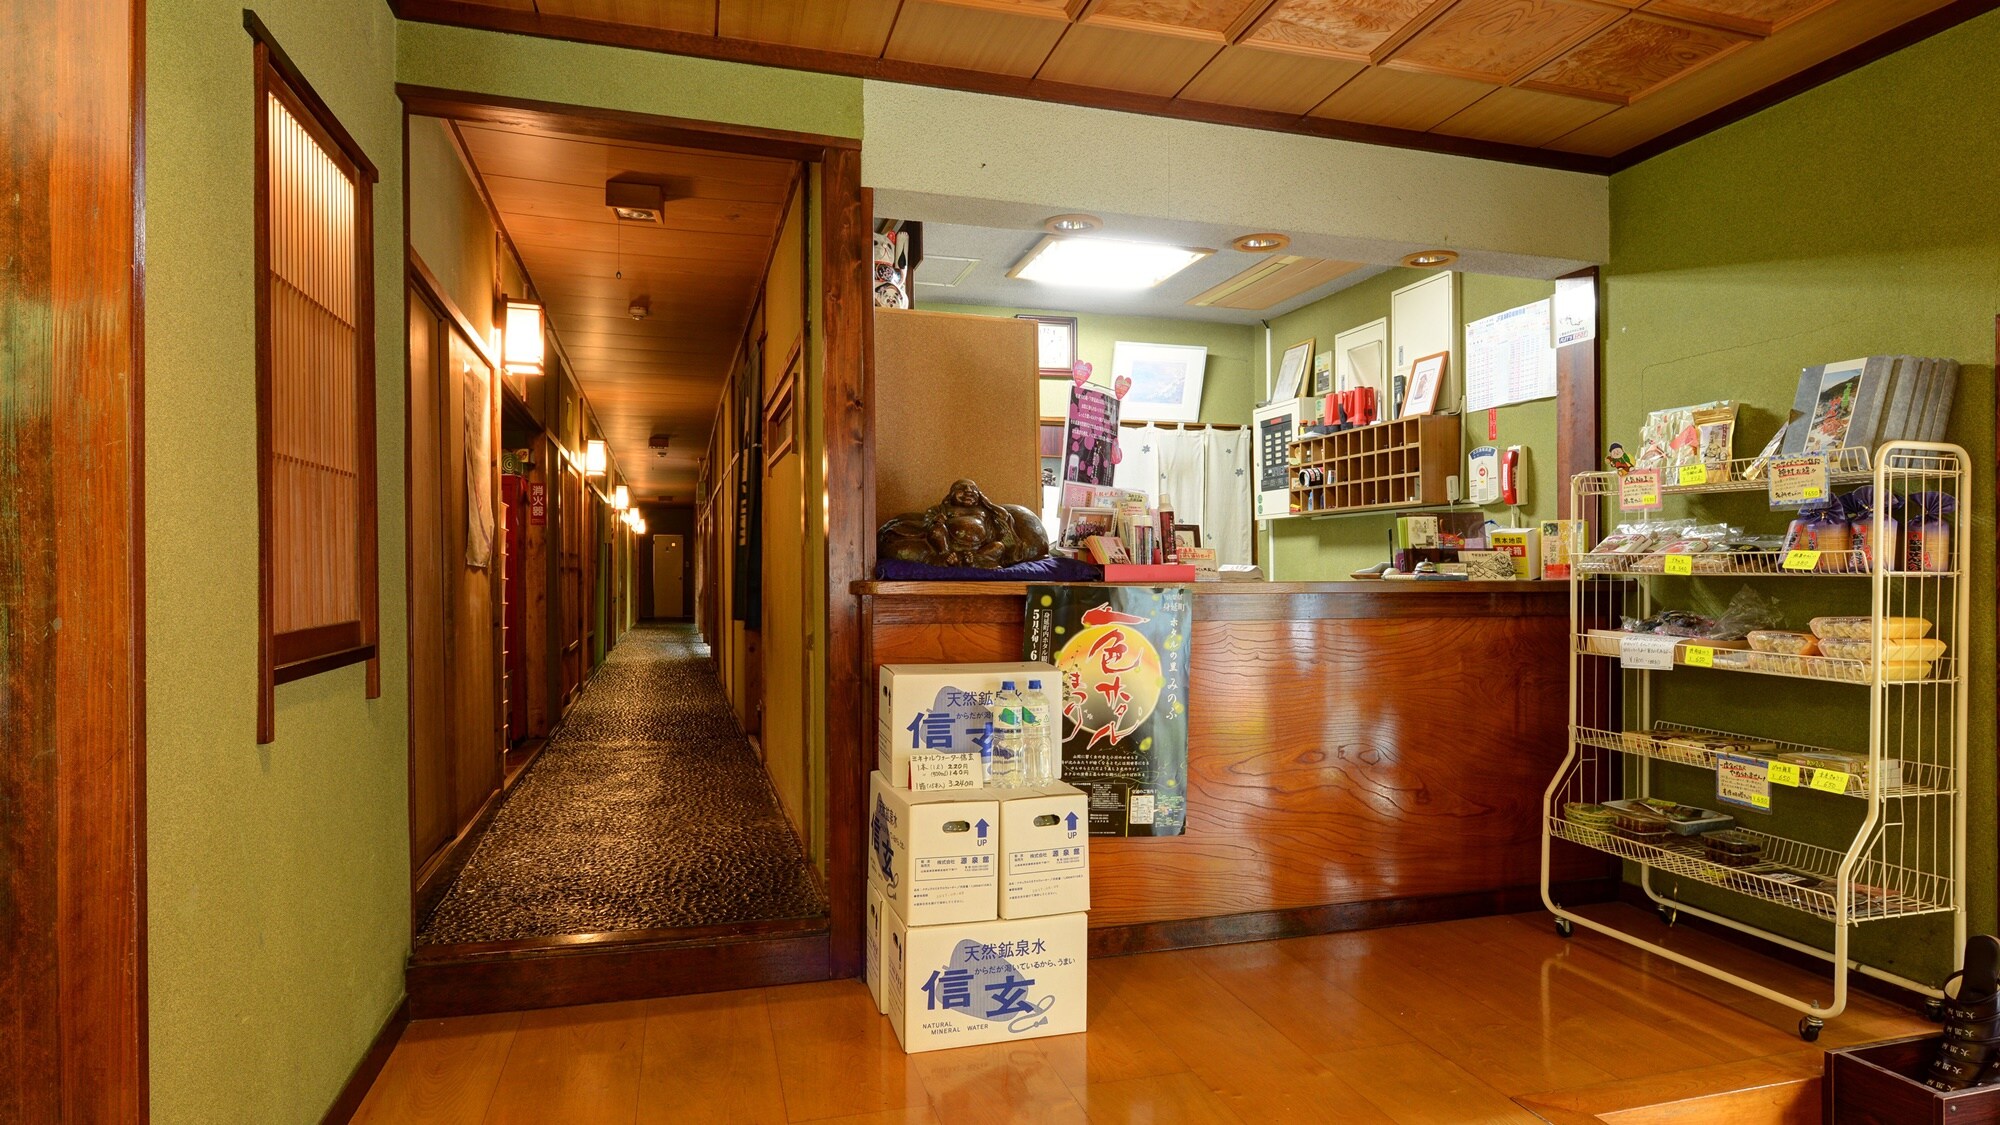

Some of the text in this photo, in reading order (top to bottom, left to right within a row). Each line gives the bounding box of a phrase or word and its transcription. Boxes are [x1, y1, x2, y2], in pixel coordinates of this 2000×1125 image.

[532, 485, 544, 516] 消火器
[956, 711, 994, 719] からだが渇
[1067, 831, 1077, 840] UP
[977, 839, 987, 847] UP
[964, 938, 1046, 963] 天然鉱泉水
[974, 957, 1076, 976] からだが渇いているから、うまい
[921, 967, 1036, 1018] 信玄
[922, 1021, 953, 1029] NATURAL
[930, 1023, 989, 1036] MINERAL WATER
